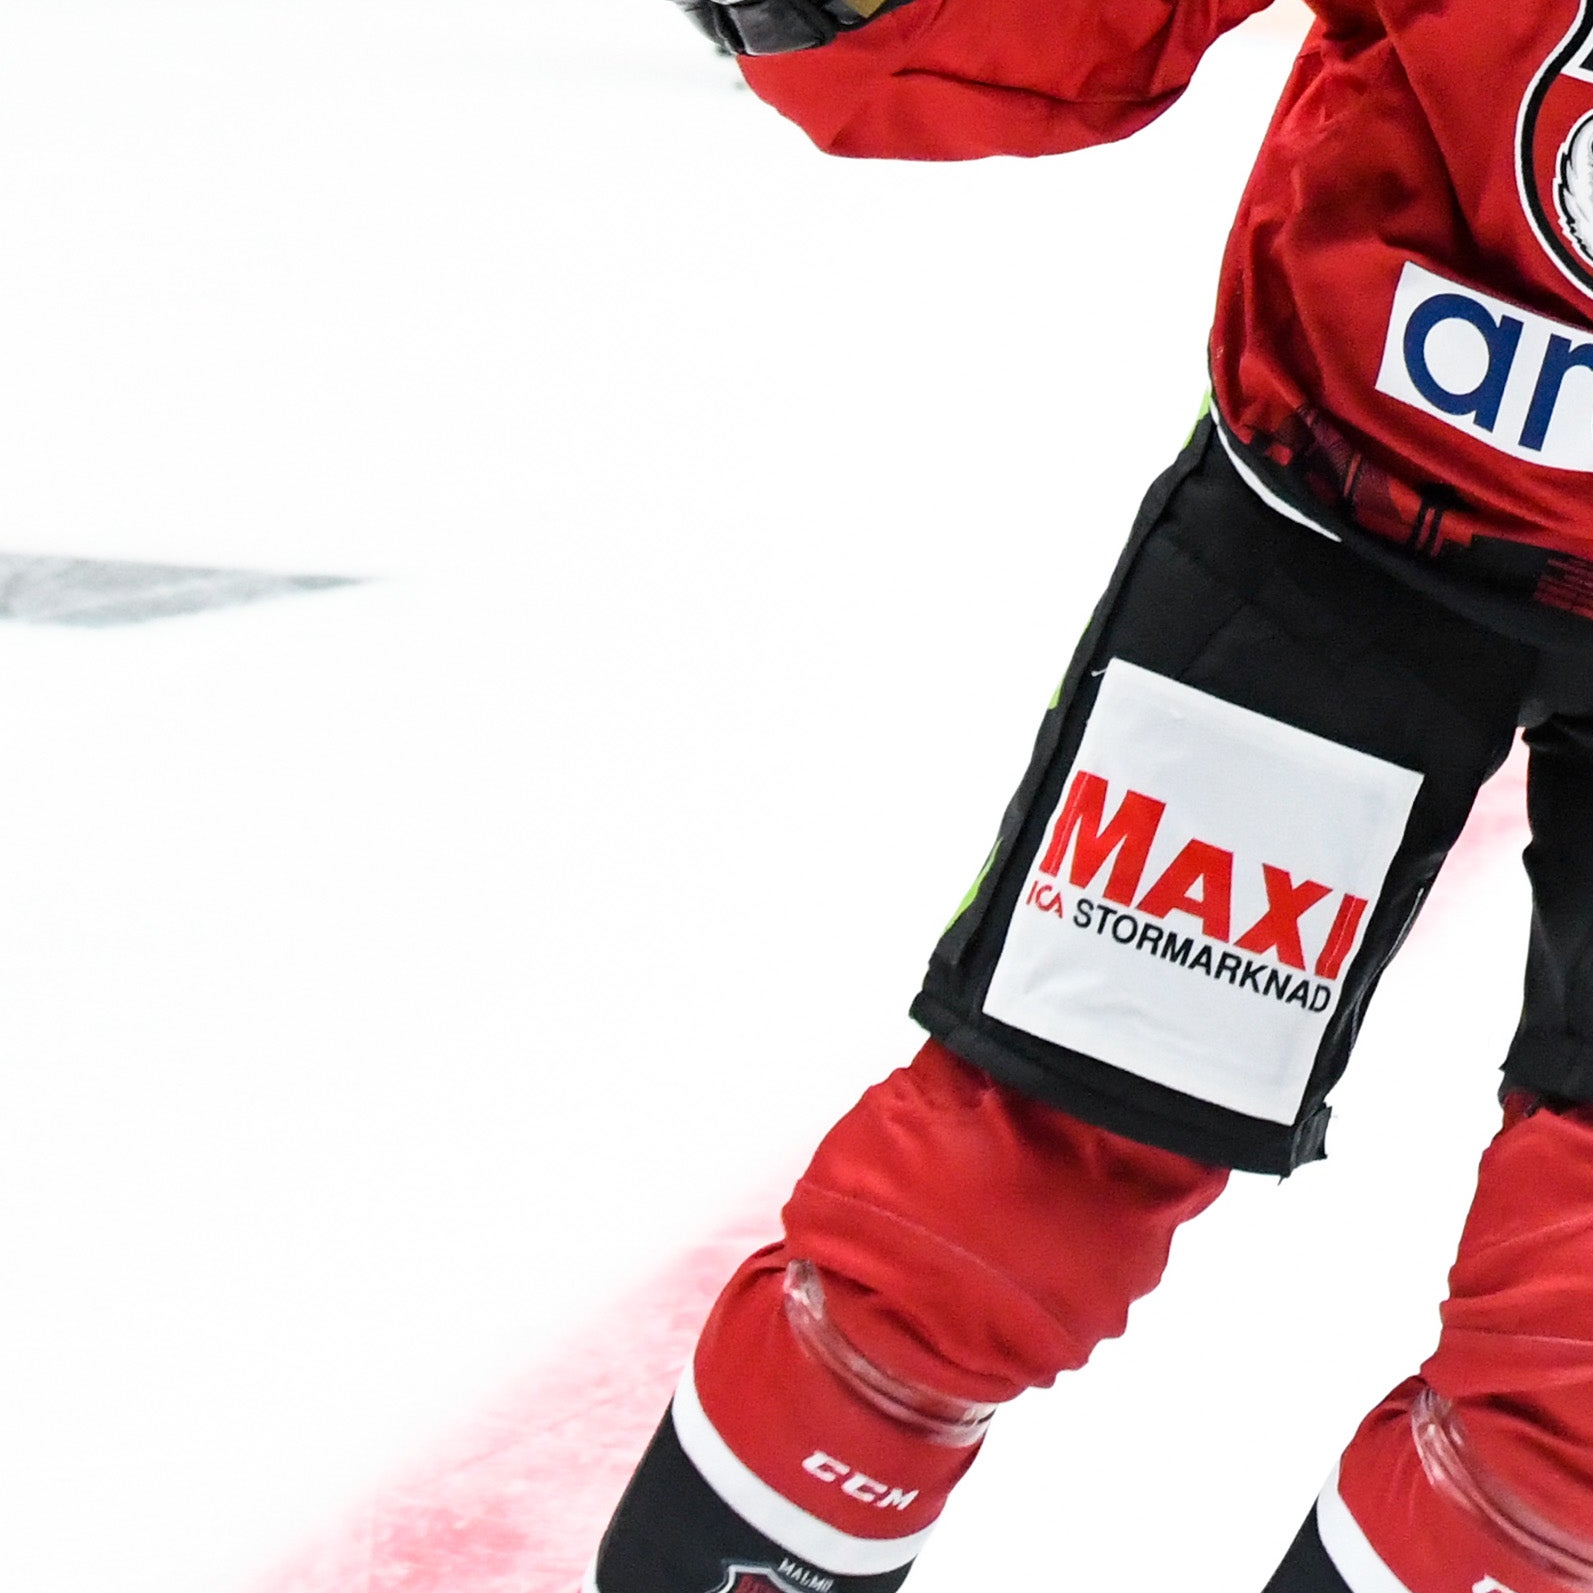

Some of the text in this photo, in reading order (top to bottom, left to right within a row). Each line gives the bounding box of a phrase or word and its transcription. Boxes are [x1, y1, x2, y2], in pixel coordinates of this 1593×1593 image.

[1038, 769, 1369, 982] MAXI
[1025, 879, 1333, 1013] ICA STORMARKNAD
[802, 1449, 920, 1512] CCM
